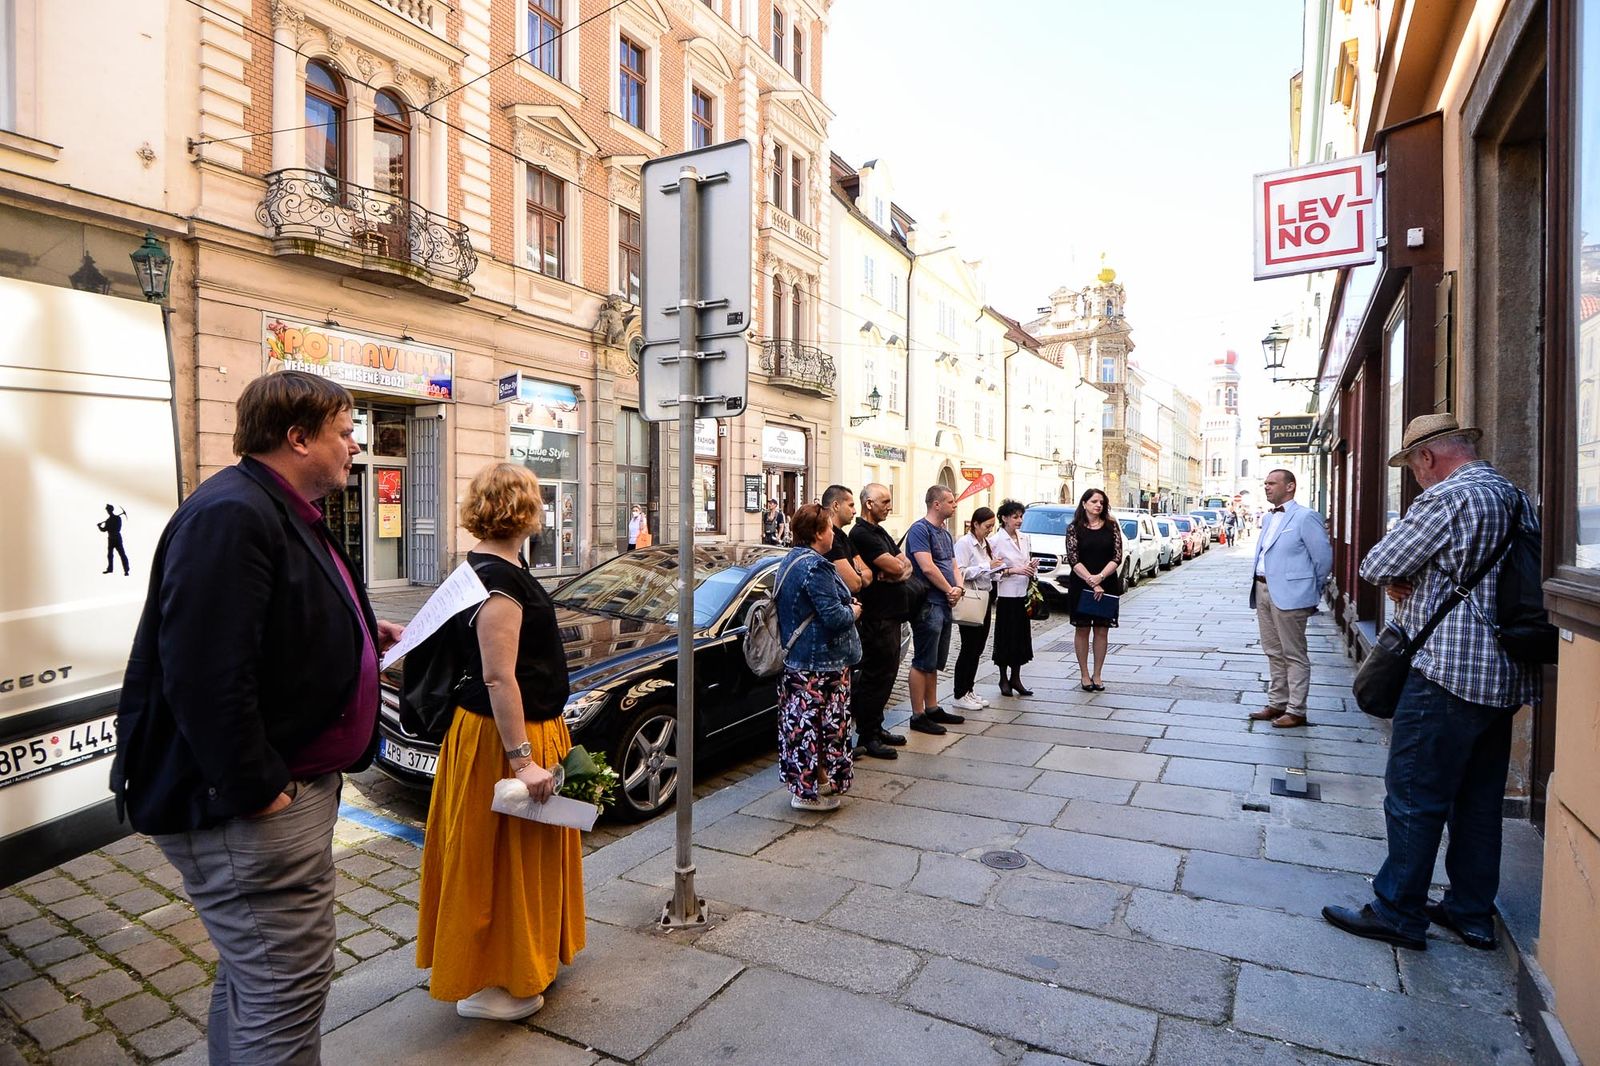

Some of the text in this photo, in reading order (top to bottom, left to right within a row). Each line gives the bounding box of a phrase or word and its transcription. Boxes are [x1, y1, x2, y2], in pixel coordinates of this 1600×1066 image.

[1278, 222, 1330, 250] NO
[284, 328, 441, 377] POTRAVINY
[284, 359, 331, 378] VEČERKA
[1272, 423, 1311, 431] ZLATNICTVÍ
[1274, 431, 1309, 439] JEWELLERY
[528, 447, 570, 459] Blue Style
[387, 743, 402, 762] 4P9
[408, 751, 437, 771] 3777
